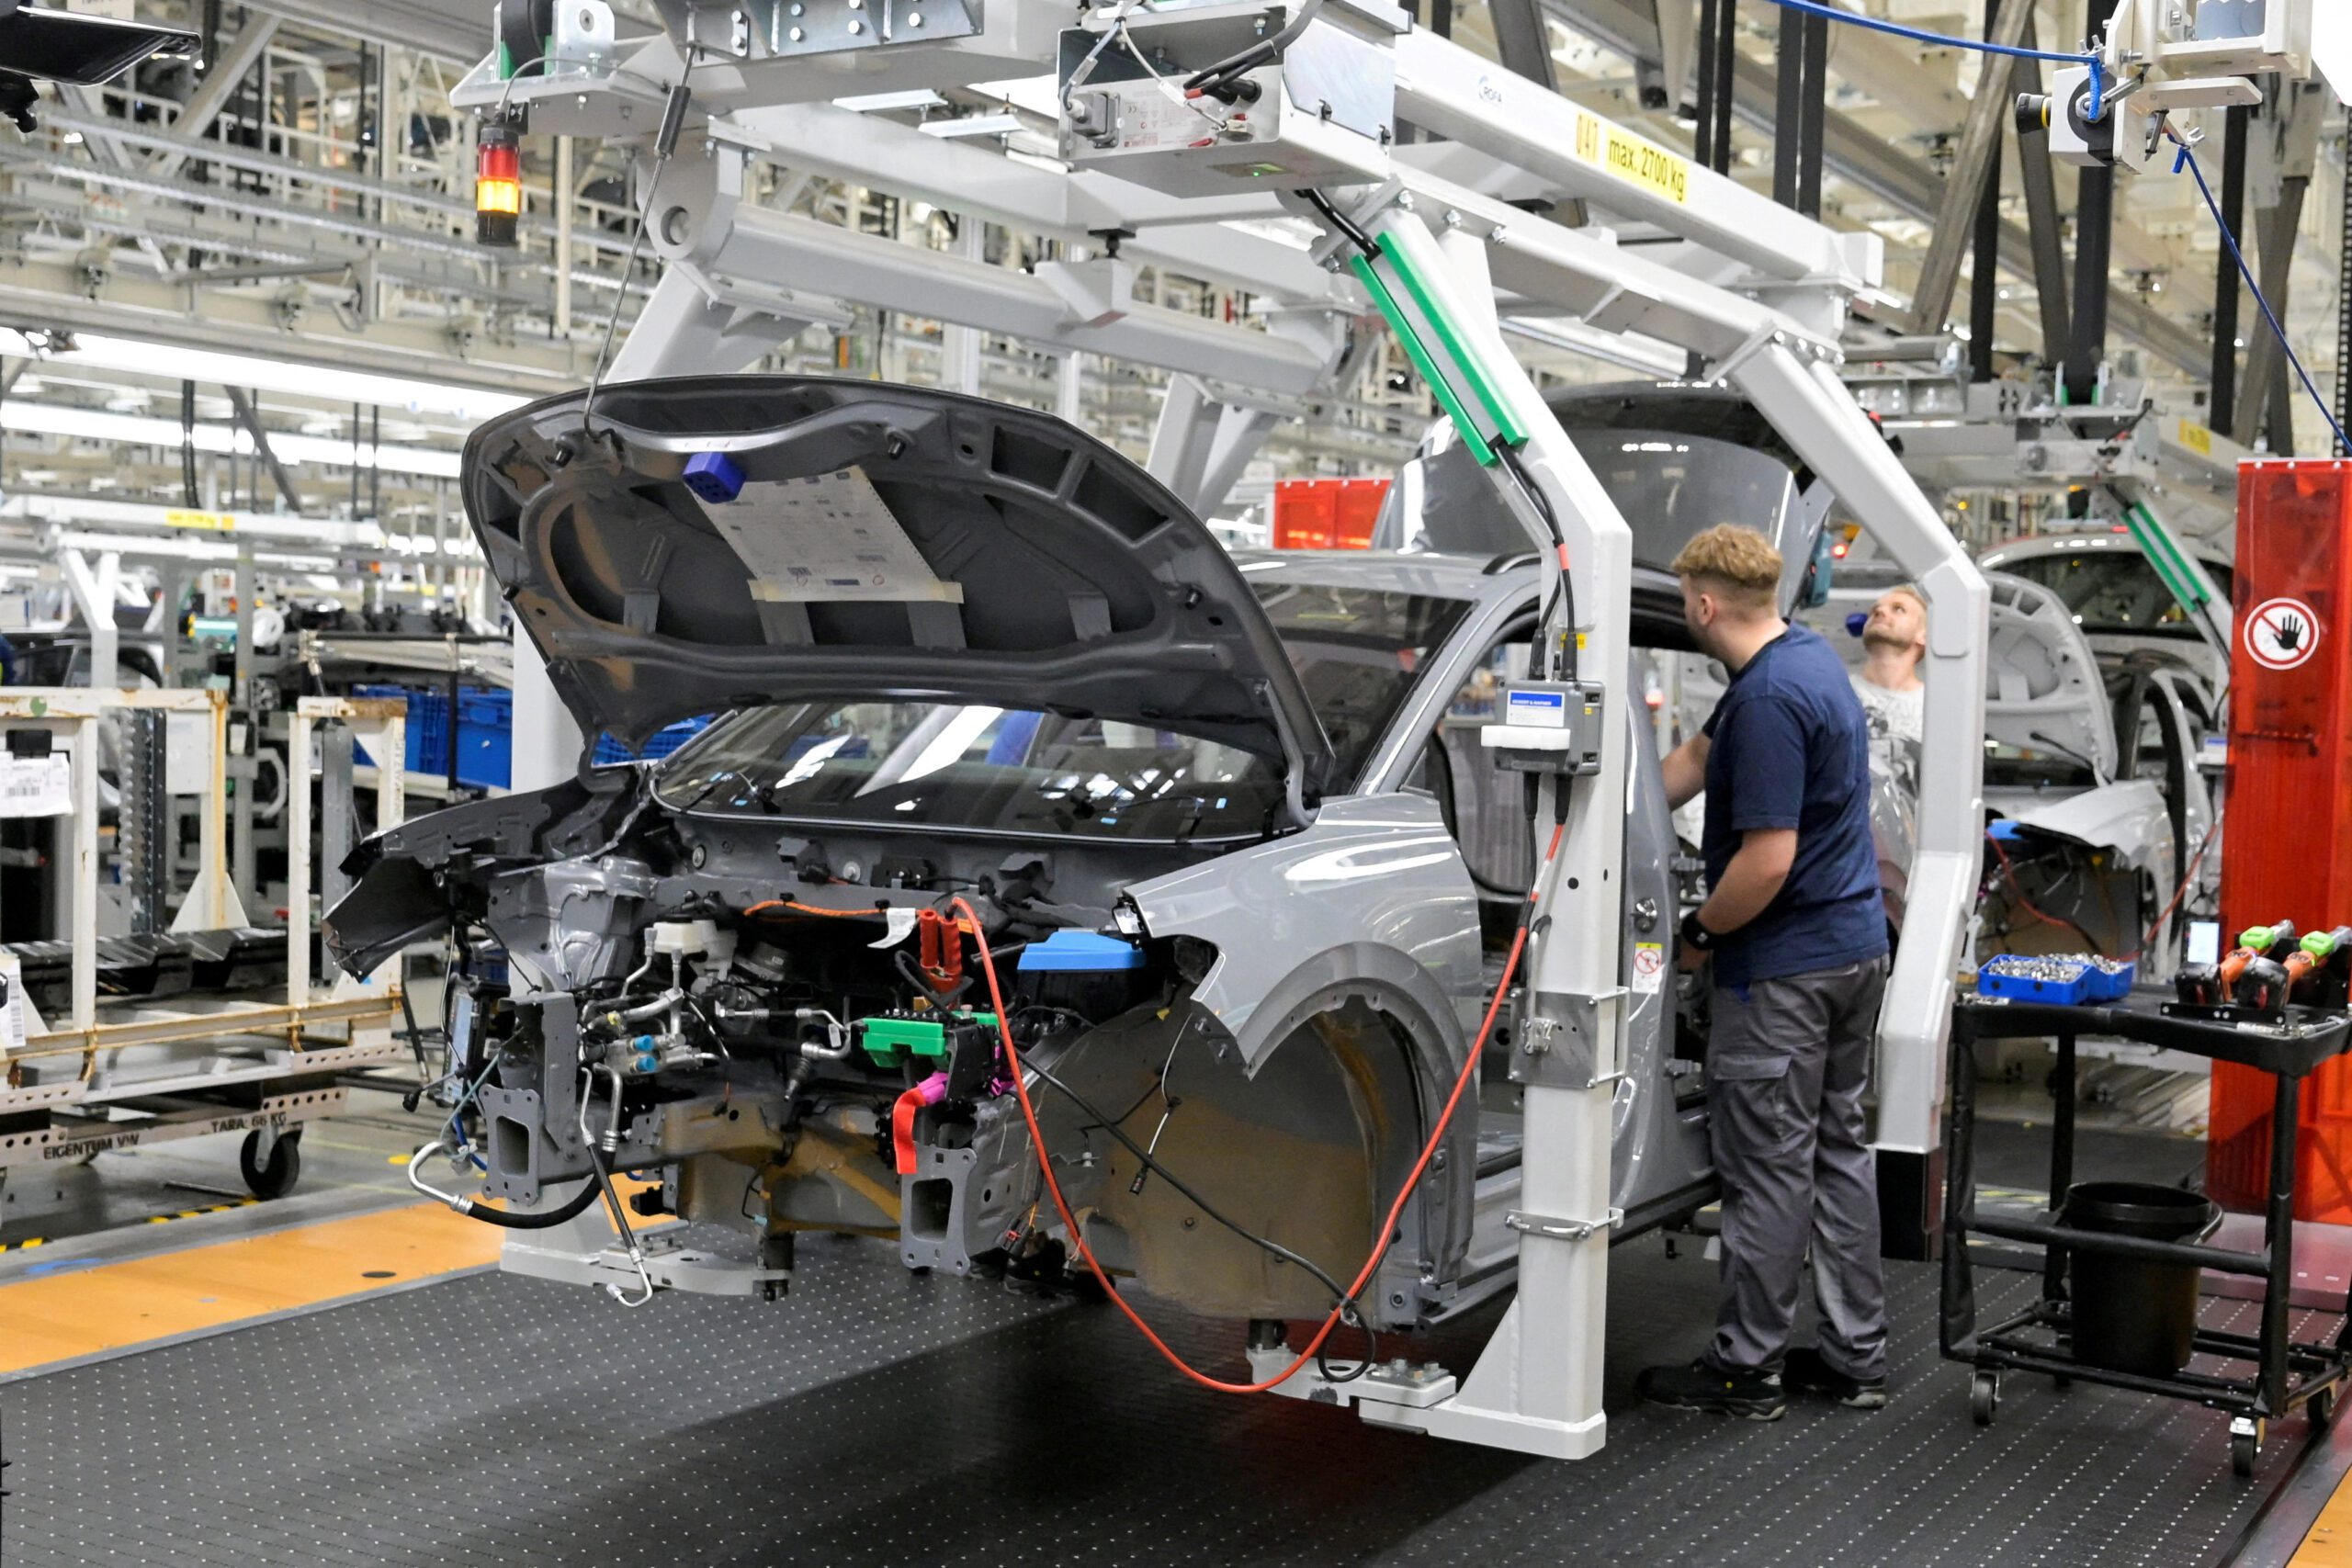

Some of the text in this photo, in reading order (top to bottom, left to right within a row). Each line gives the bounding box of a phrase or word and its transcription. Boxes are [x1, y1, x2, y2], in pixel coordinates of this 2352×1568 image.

[1610, 140, 1684, 201] max. 2700 kg
[44, 1134, 139, 1160] EIGENTUM VW
